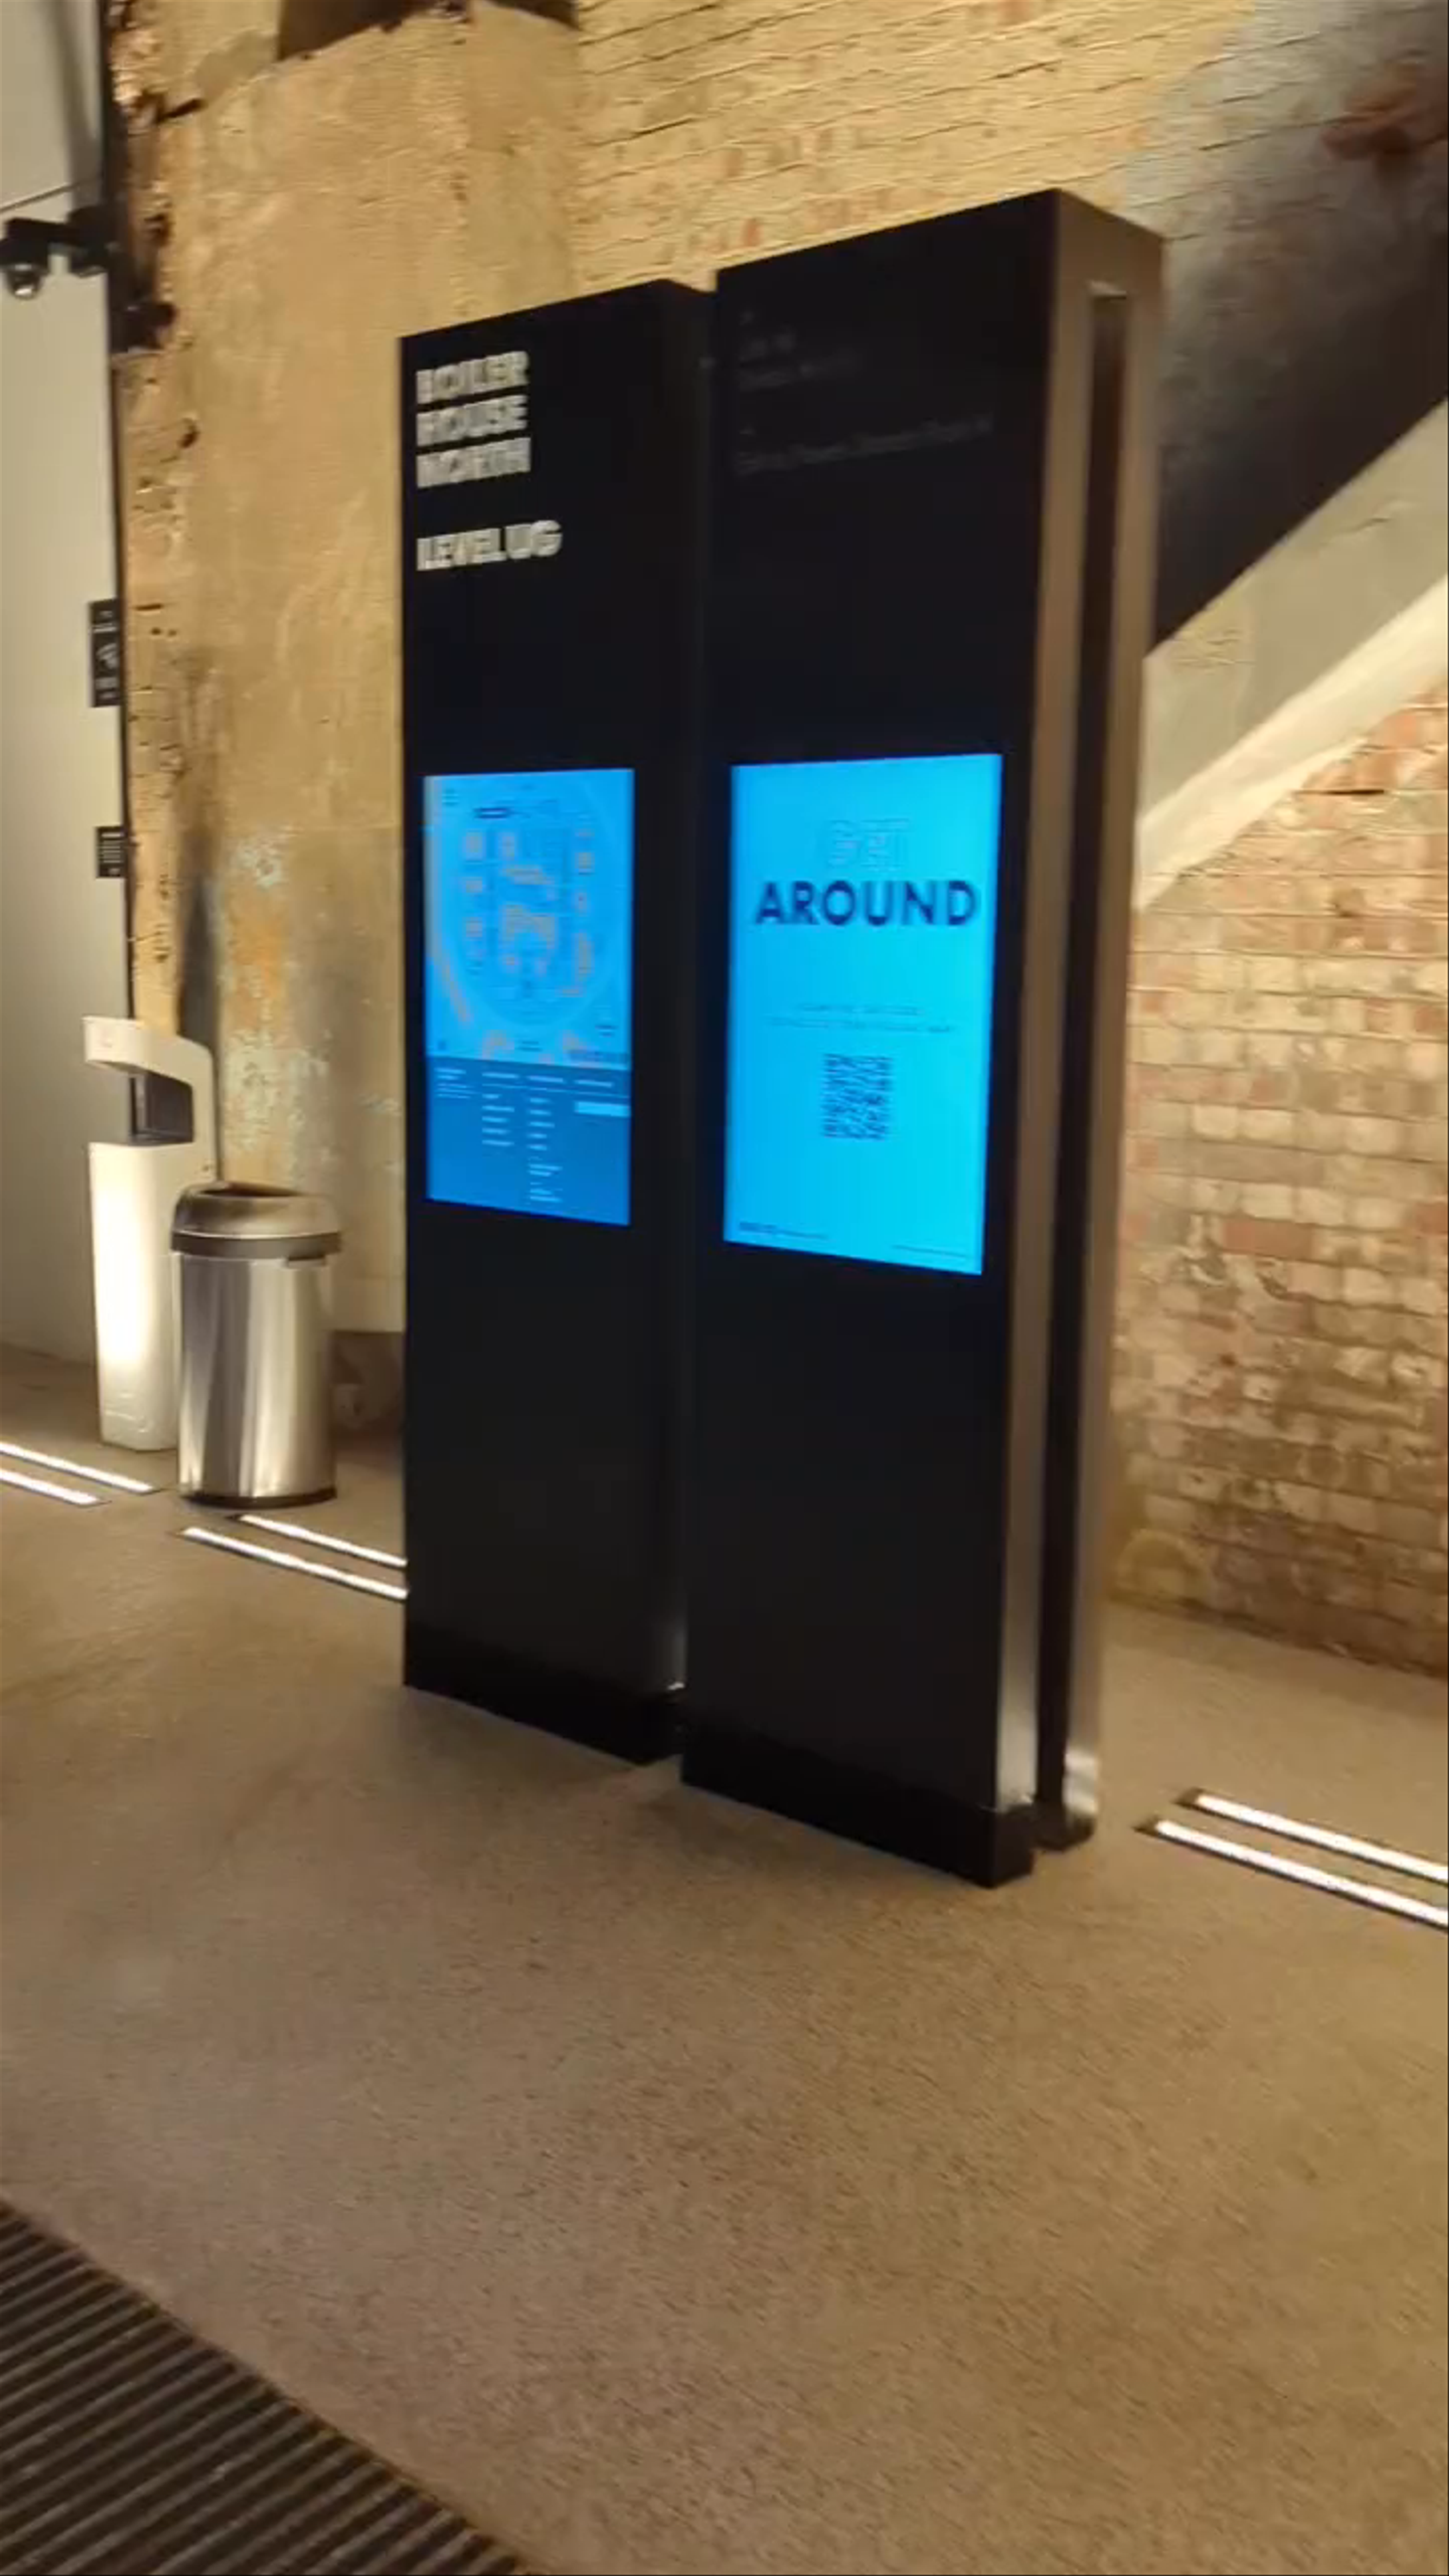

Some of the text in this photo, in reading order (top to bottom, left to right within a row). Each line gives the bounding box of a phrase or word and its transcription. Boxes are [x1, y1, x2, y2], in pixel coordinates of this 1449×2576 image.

[416, 351, 529, 404] BOILER
[417, 394, 527, 447] HOUSE
[417, 437, 531, 488] NORTH
[417, 520, 563, 571] LEVEL UG
[754, 880, 978, 926] AROUND
